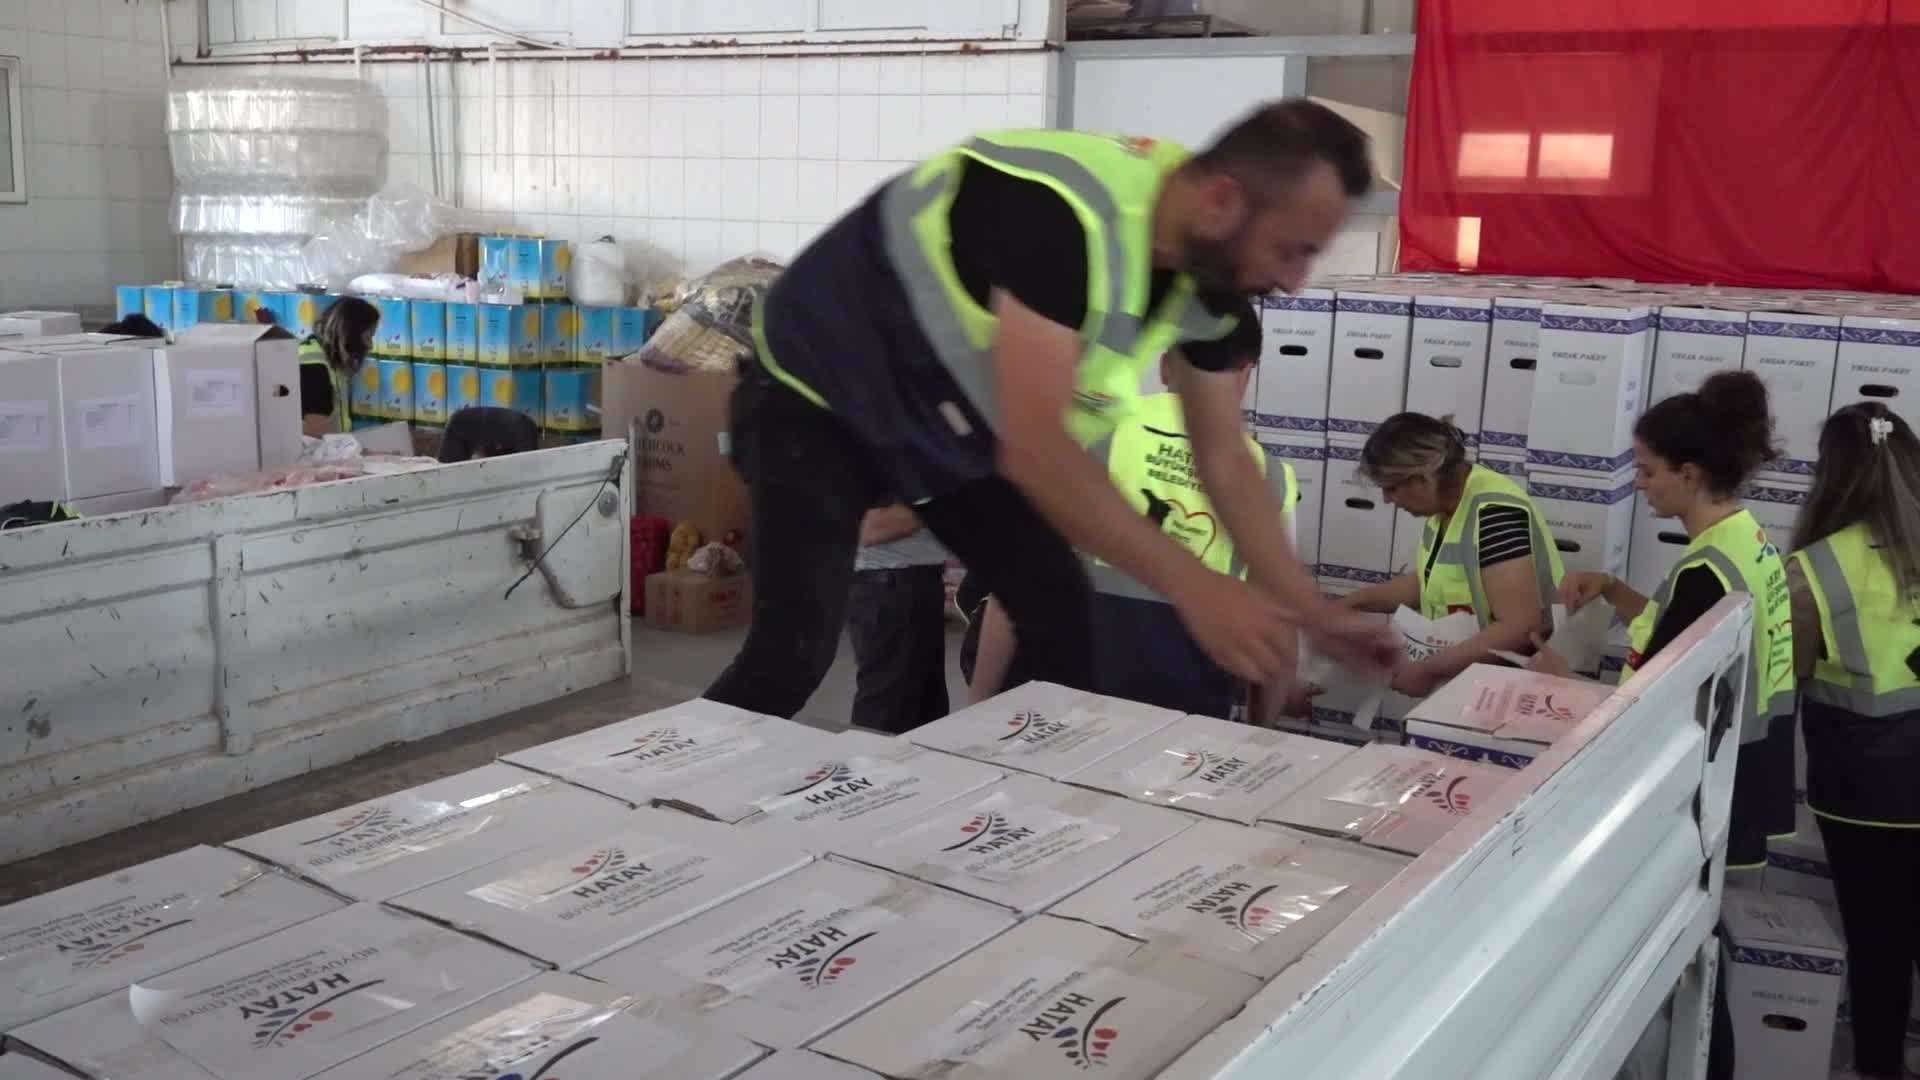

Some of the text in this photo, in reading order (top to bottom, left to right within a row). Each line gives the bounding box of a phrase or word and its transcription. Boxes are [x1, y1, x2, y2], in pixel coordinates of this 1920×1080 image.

[1020, 721, 1070, 743] HATAY
[634, 738, 696, 760] HATAY
[1200, 757, 1248, 783] HATAY
[805, 777, 872, 804] HATAY
[968, 827, 1035, 853] HATAY
[573, 862, 652, 898] HATAY
[1186, 882, 1252, 913] HATAY
[768, 926, 847, 969] HATAY
[240, 972, 350, 1019] HATAY
[1019, 992, 1094, 1042] HATAY
